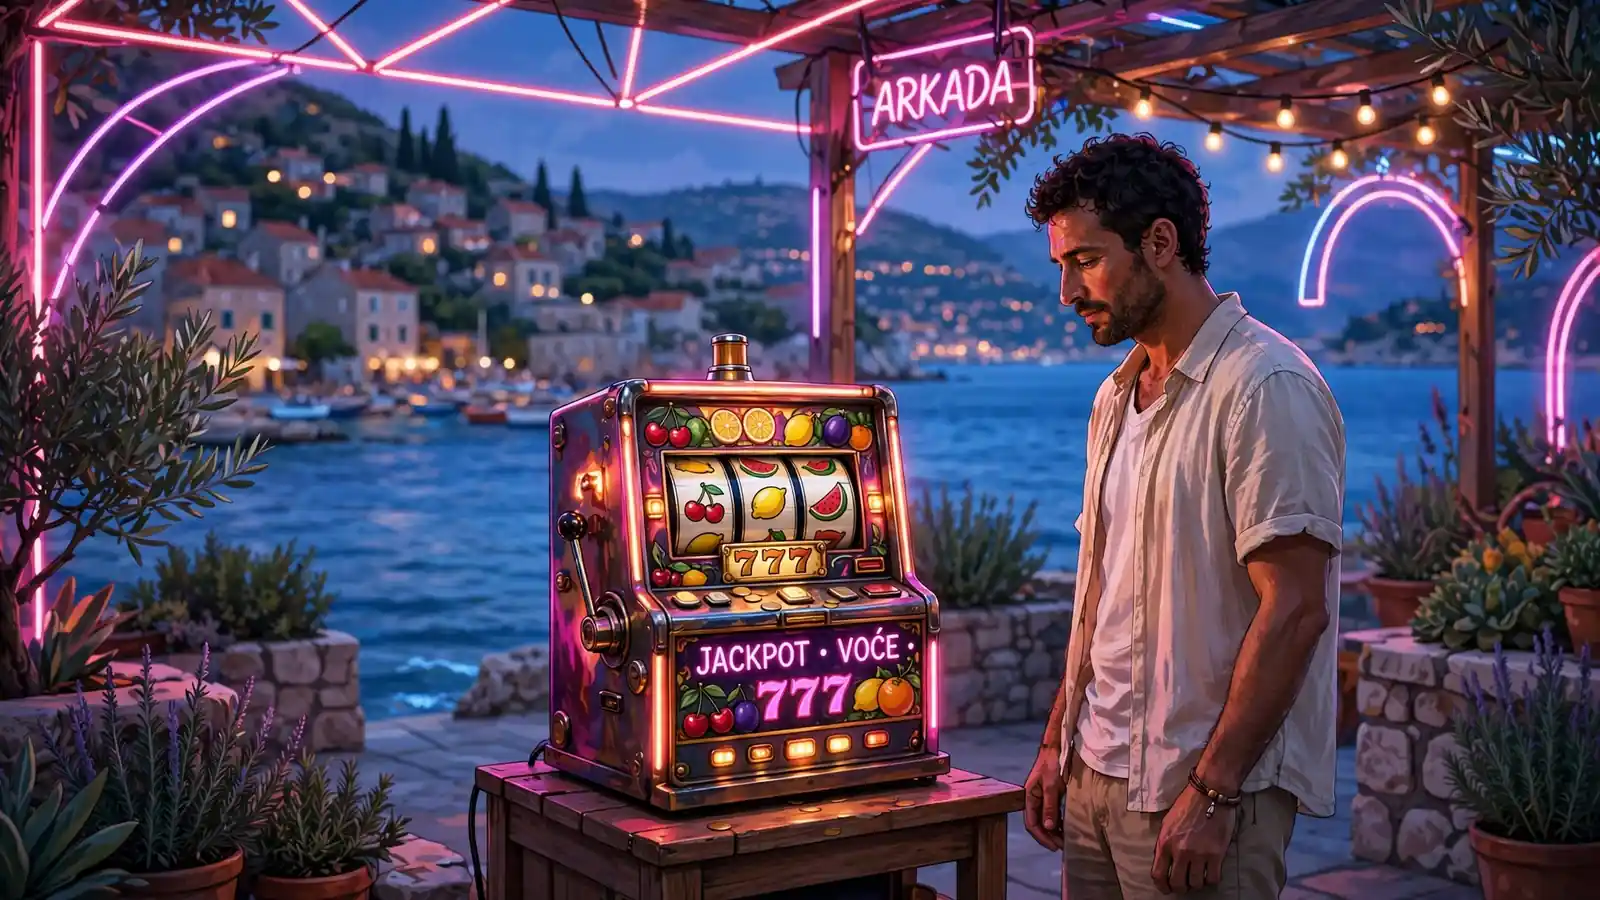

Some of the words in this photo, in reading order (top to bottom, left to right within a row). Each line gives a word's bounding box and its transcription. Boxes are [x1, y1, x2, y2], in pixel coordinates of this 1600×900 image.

[871, 60, 1014, 126] ARKADA
[733, 547, 813, 577] 777
[696, 640, 810, 676] JACKPOT
[837, 627, 900, 663] VOĆE
[756, 673, 853, 722] 777
